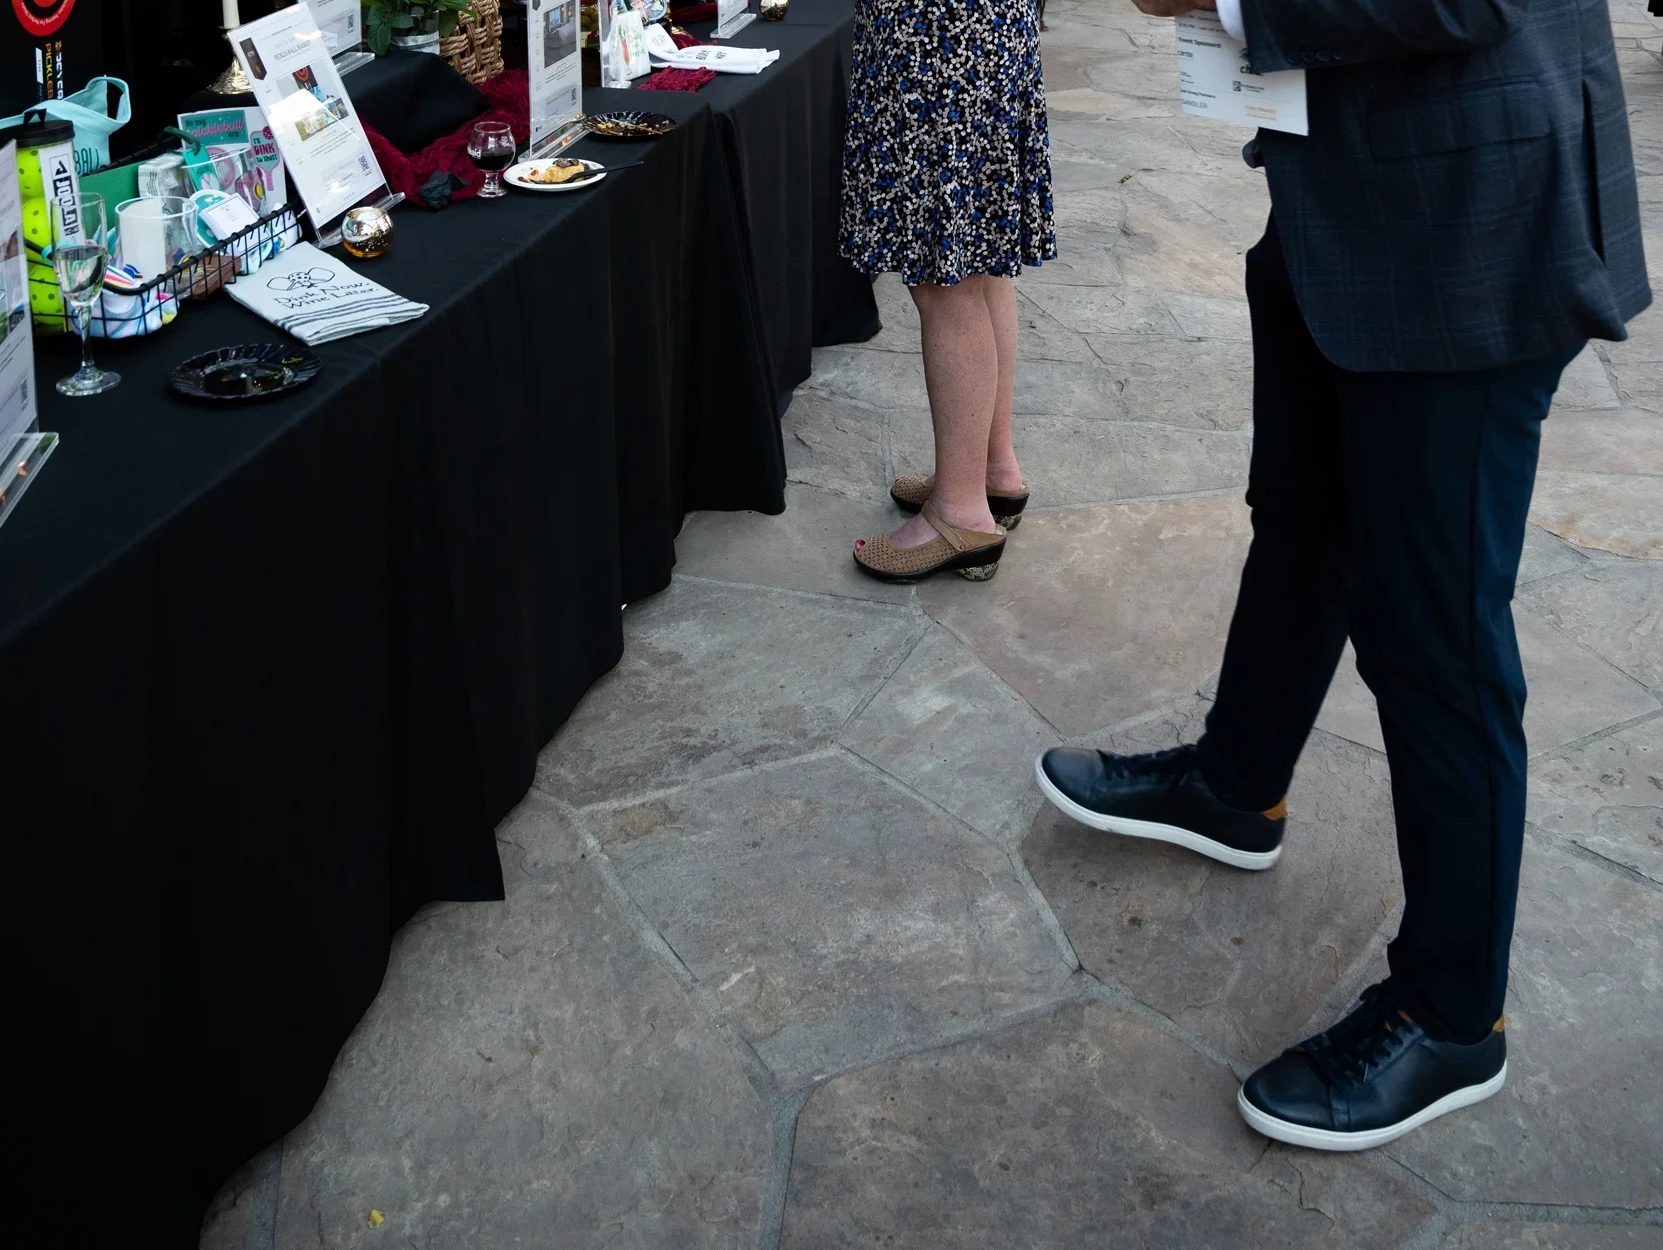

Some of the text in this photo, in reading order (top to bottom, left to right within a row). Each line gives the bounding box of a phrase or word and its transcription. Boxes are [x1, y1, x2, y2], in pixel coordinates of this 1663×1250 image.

[1178, 36, 1194, 45] Event
[195, 117, 207, 127] my
[253, 142, 275, 156] DINK
[54, 176, 79, 227] JOOLA
[274, 282, 370, 303] Dink Now.
[283, 288, 379, 309] Wine Later.
